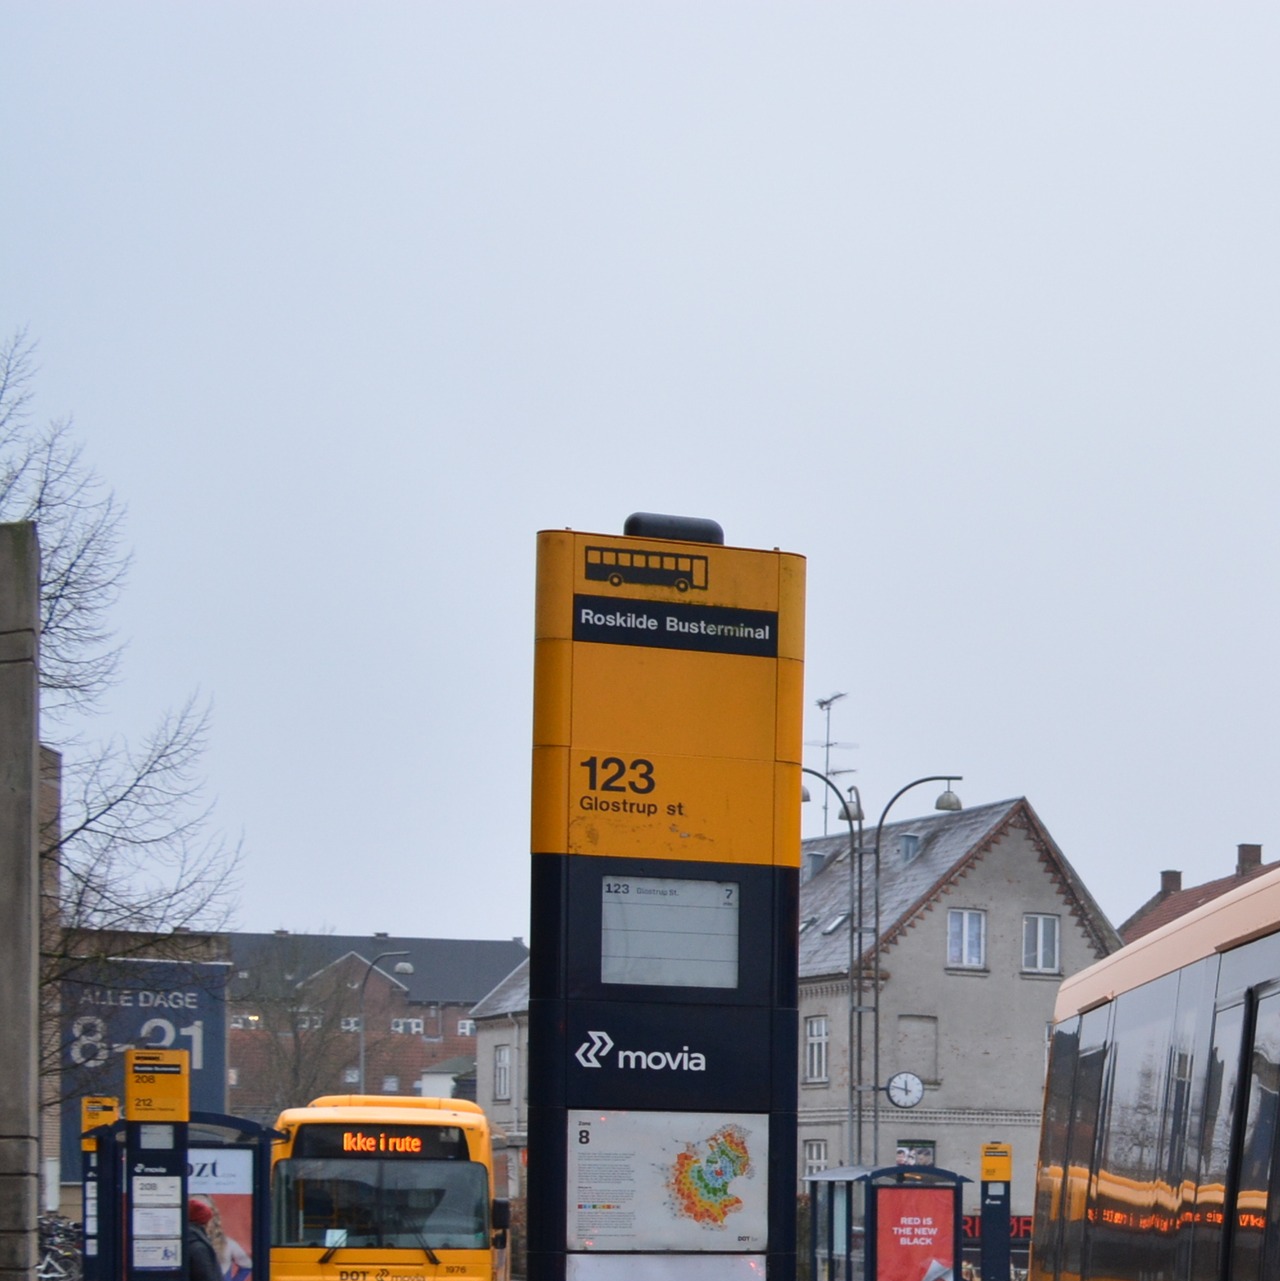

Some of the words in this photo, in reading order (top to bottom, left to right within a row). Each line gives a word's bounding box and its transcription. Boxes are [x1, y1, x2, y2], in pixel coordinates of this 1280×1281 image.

[580, 608, 659, 631] Roskilde
[666, 616, 770, 640] Busterminal
[579, 756, 657, 795] 123
[579, 795, 659, 817] Glostrup
[666, 801, 684, 816] st
[605, 883, 631, 895] 123
[724, 888, 733, 900] 7
[79, 988, 133, 1007] ALLE
[138, 990, 199, 1010] DAGE
[617, 1045, 707, 1072] movia
[134, 1074, 156, 1084] 208
[134, 1097, 153, 1107] 212
[343, 1131, 377, 1152] Ikke
[379, 1132, 387, 1152] i
[388, 1135, 422, 1153] rute
[578, 1129, 590, 1145] 8
[139, 1182, 158, 1191] 208
[900, 1217, 921, 1225] RED
[922, 1217, 933, 1225] IS
[892, 1226, 912, 1235] THE
[914, 1227, 938, 1236] NEW
[899, 1237, 933, 1246] BLACK
[339, 1270, 370, 1281] DOT
[445, 1265, 467, 1274] 1976
